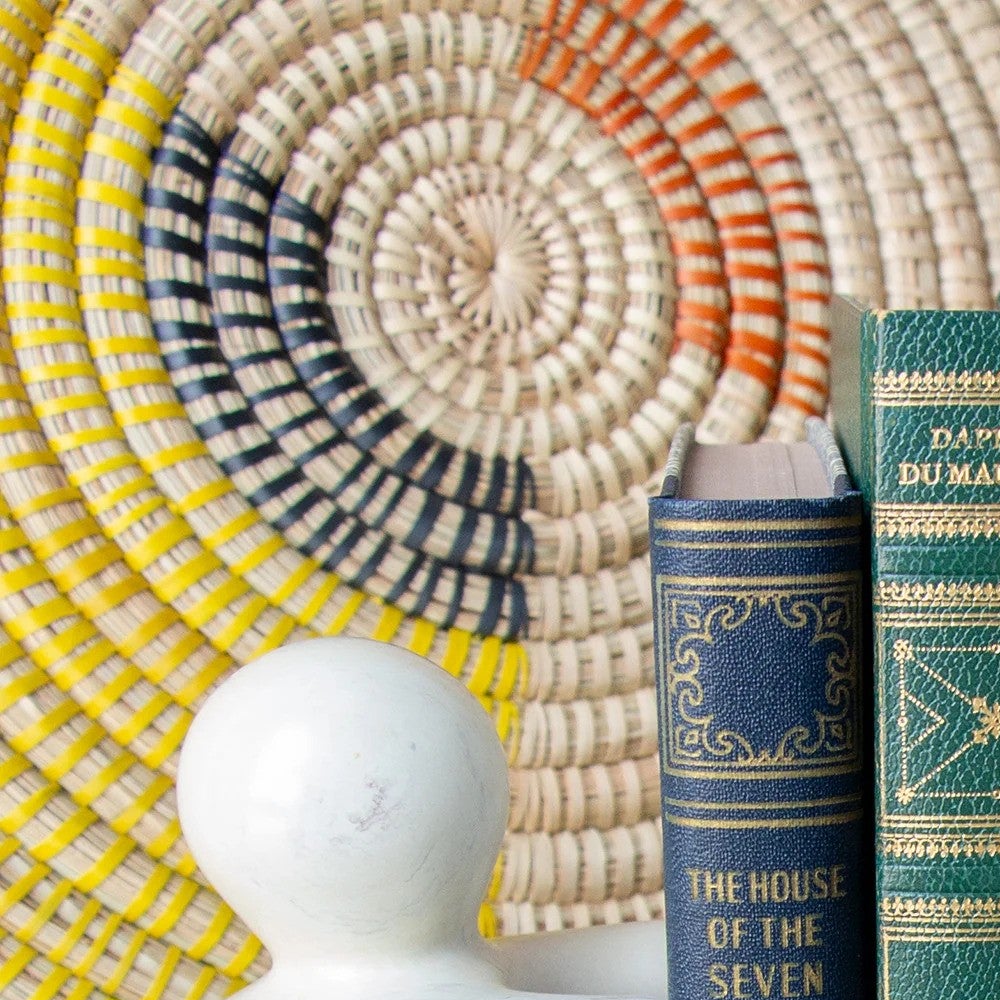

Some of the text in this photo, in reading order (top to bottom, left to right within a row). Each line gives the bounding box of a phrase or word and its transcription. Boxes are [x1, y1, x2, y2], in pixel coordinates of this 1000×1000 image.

[898, 462, 942, 486] DU
[687, 864, 847, 903] THE HOUSE
[706, 913, 824, 949] OF THE
[708, 961, 824, 999] SEVEN
